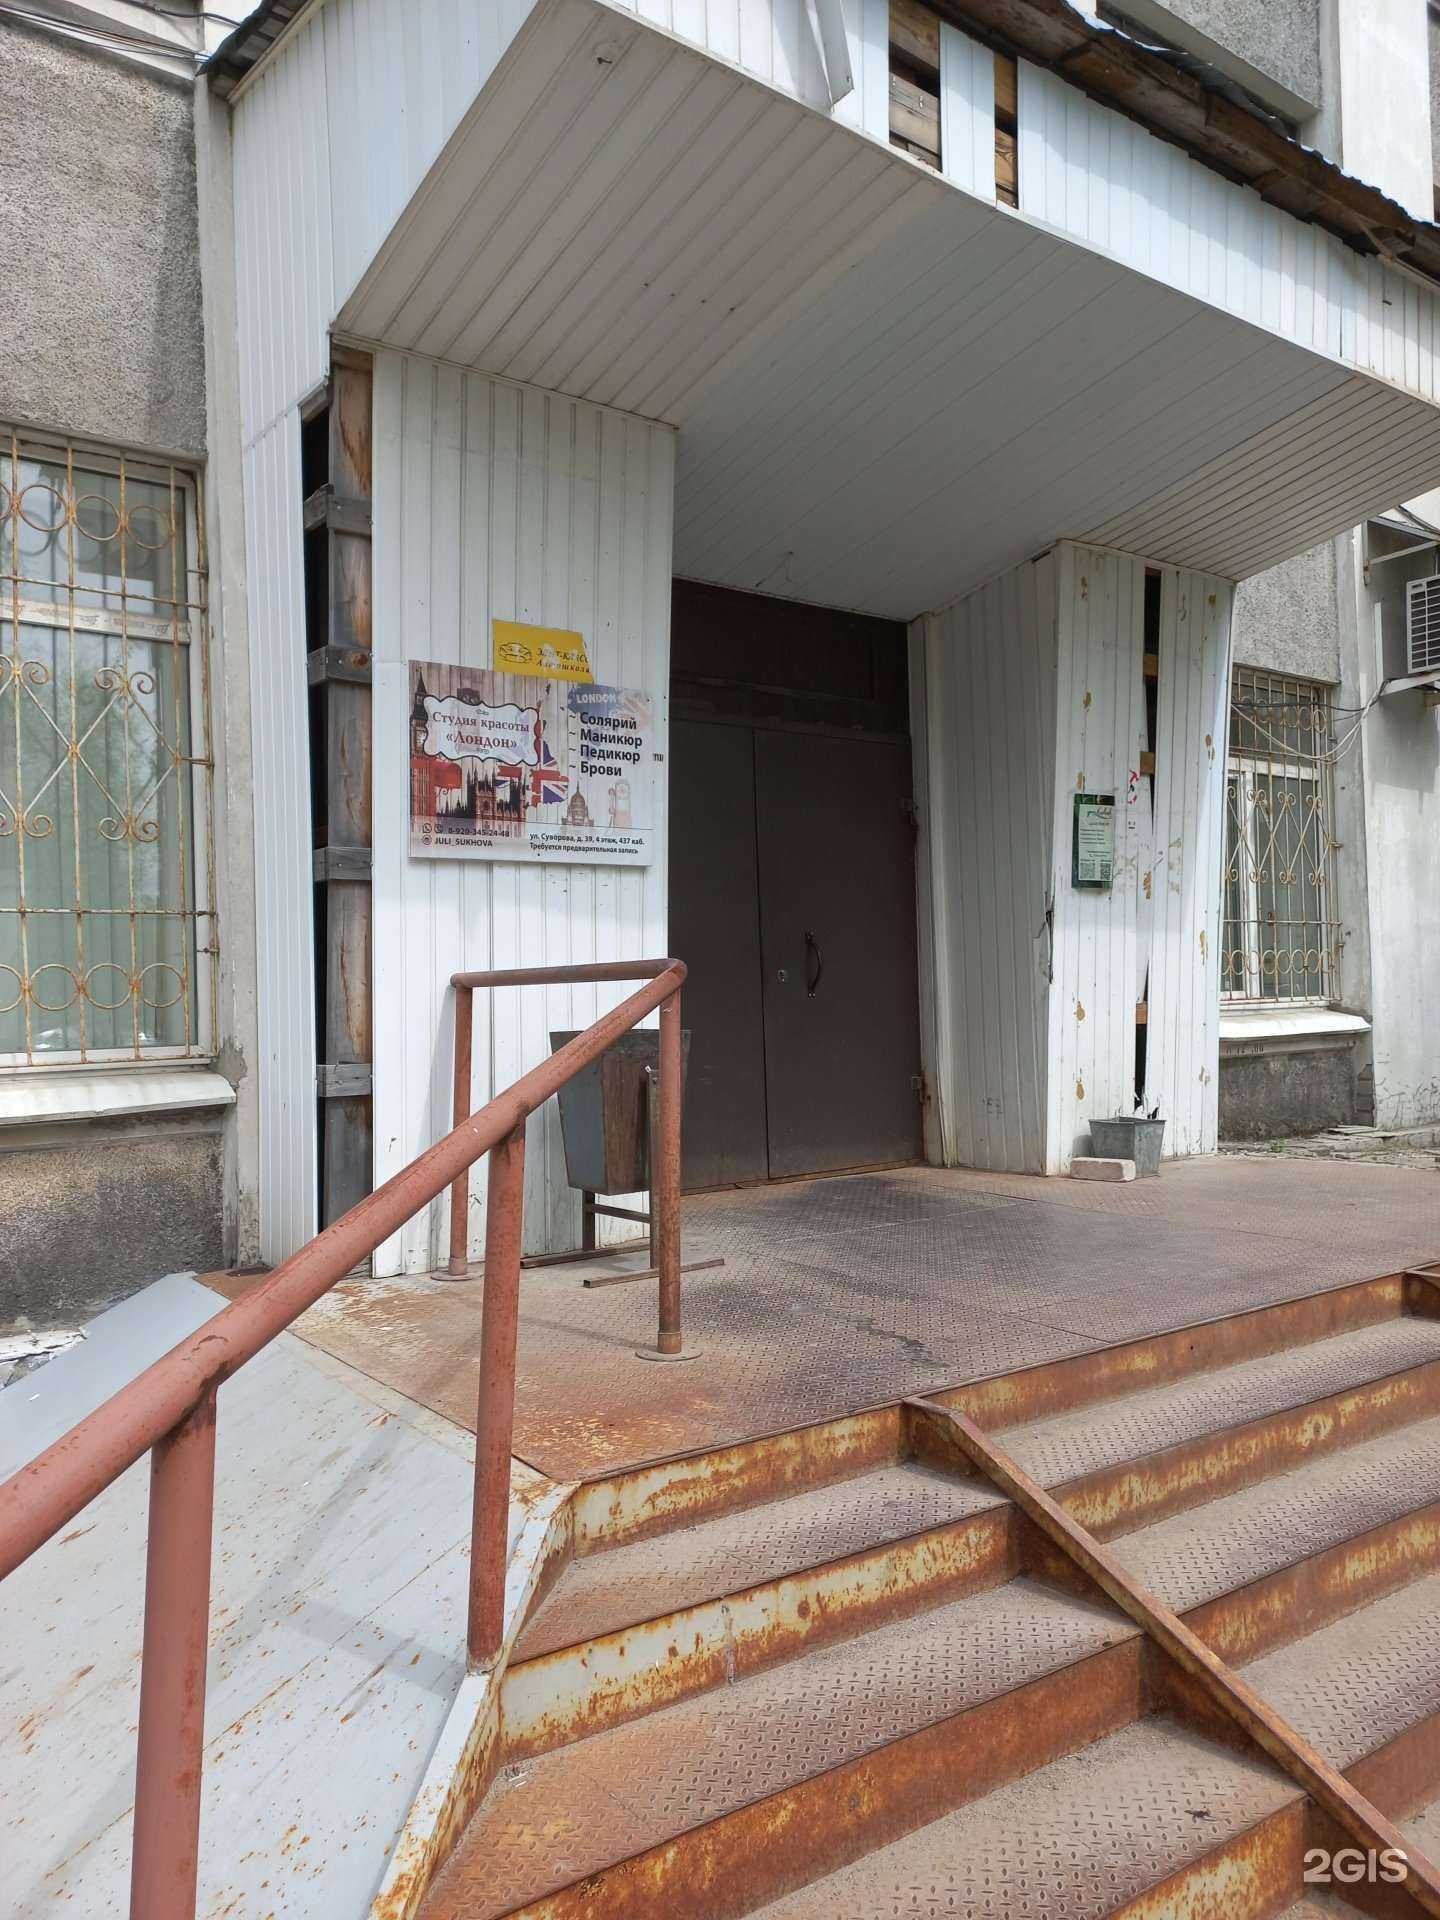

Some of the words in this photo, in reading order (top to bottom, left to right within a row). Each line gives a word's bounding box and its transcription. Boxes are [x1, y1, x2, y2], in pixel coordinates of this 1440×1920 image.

[576, 692, 617, 704] LONDON
[433, 711, 477, 727] Студия
[480, 719, 529, 733] красоты
[580, 712, 637, 730] Солярий
[446, 730, 517, 749] «Лондон»
[580, 728, 643, 749] Маникюр
[580, 744, 641, 765] Педикюр
[580, 761, 622, 777] Брови
[435, 837, 493, 847] JULI_SUKHOVA
[541, 833, 575, 843] Суворова,
[530, 842, 561, 851] Требуется
[562, 844, 617, 854] предварительная
